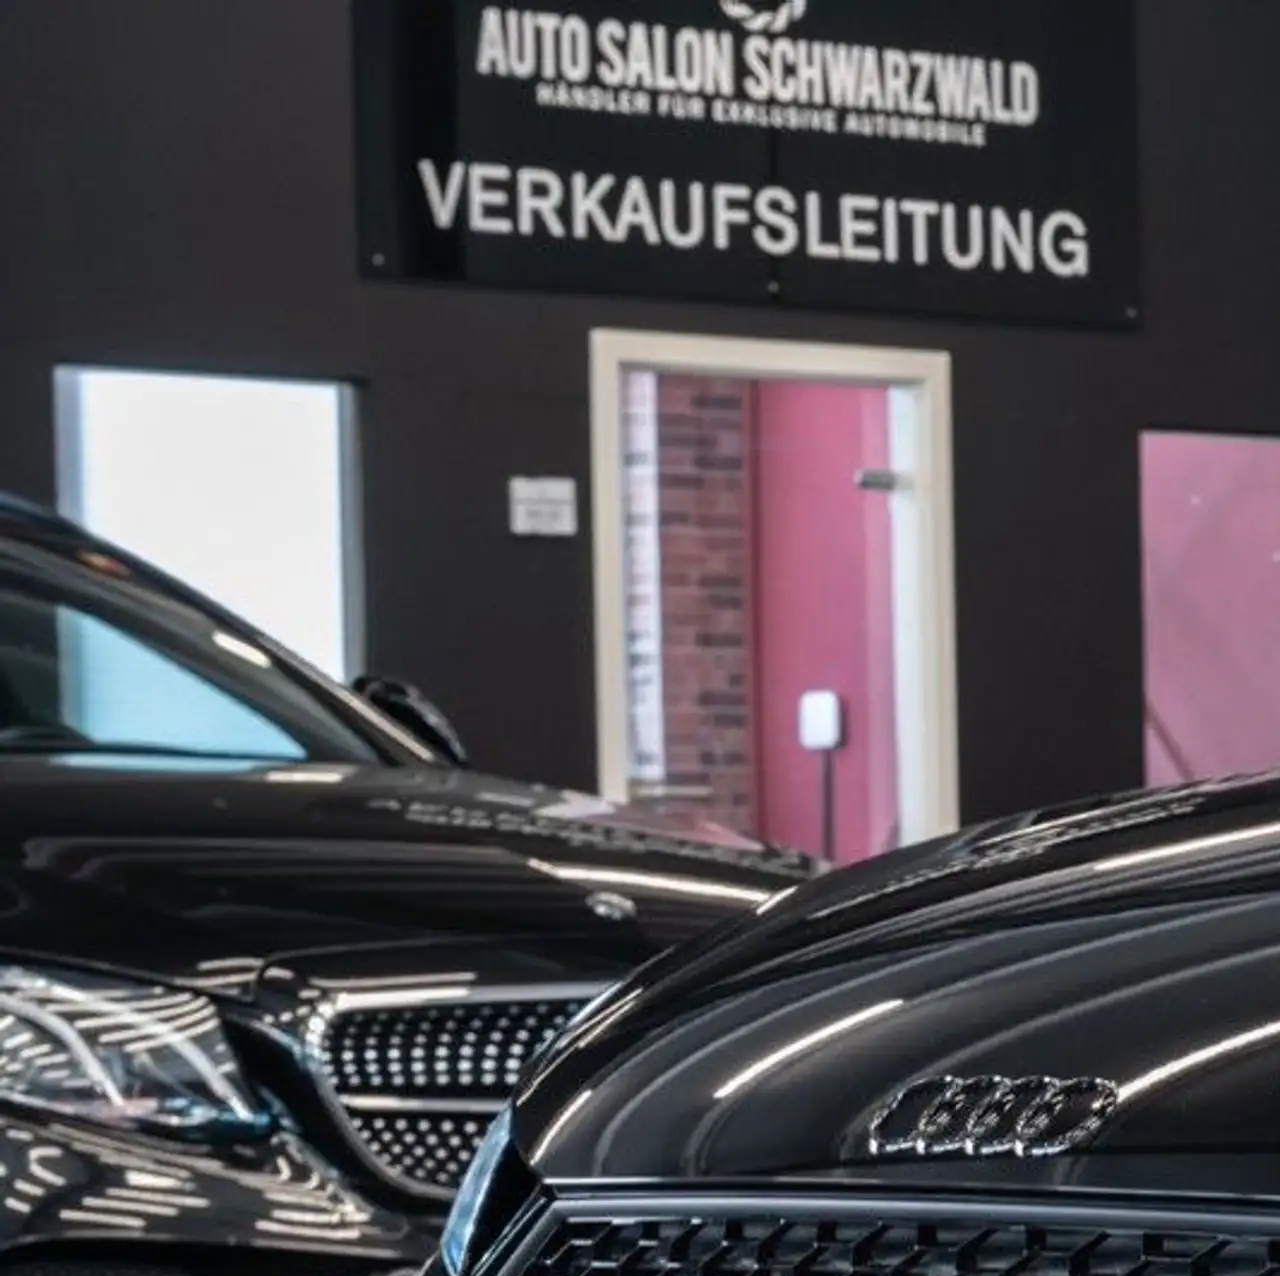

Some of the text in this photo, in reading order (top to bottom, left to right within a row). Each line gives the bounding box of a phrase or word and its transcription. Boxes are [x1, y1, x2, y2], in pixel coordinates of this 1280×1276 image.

[477, 6, 1039, 126] AUTO SALON SCHWARZWALD
[418, 159, 1089, 277] VERKAUFSLEITUNG
